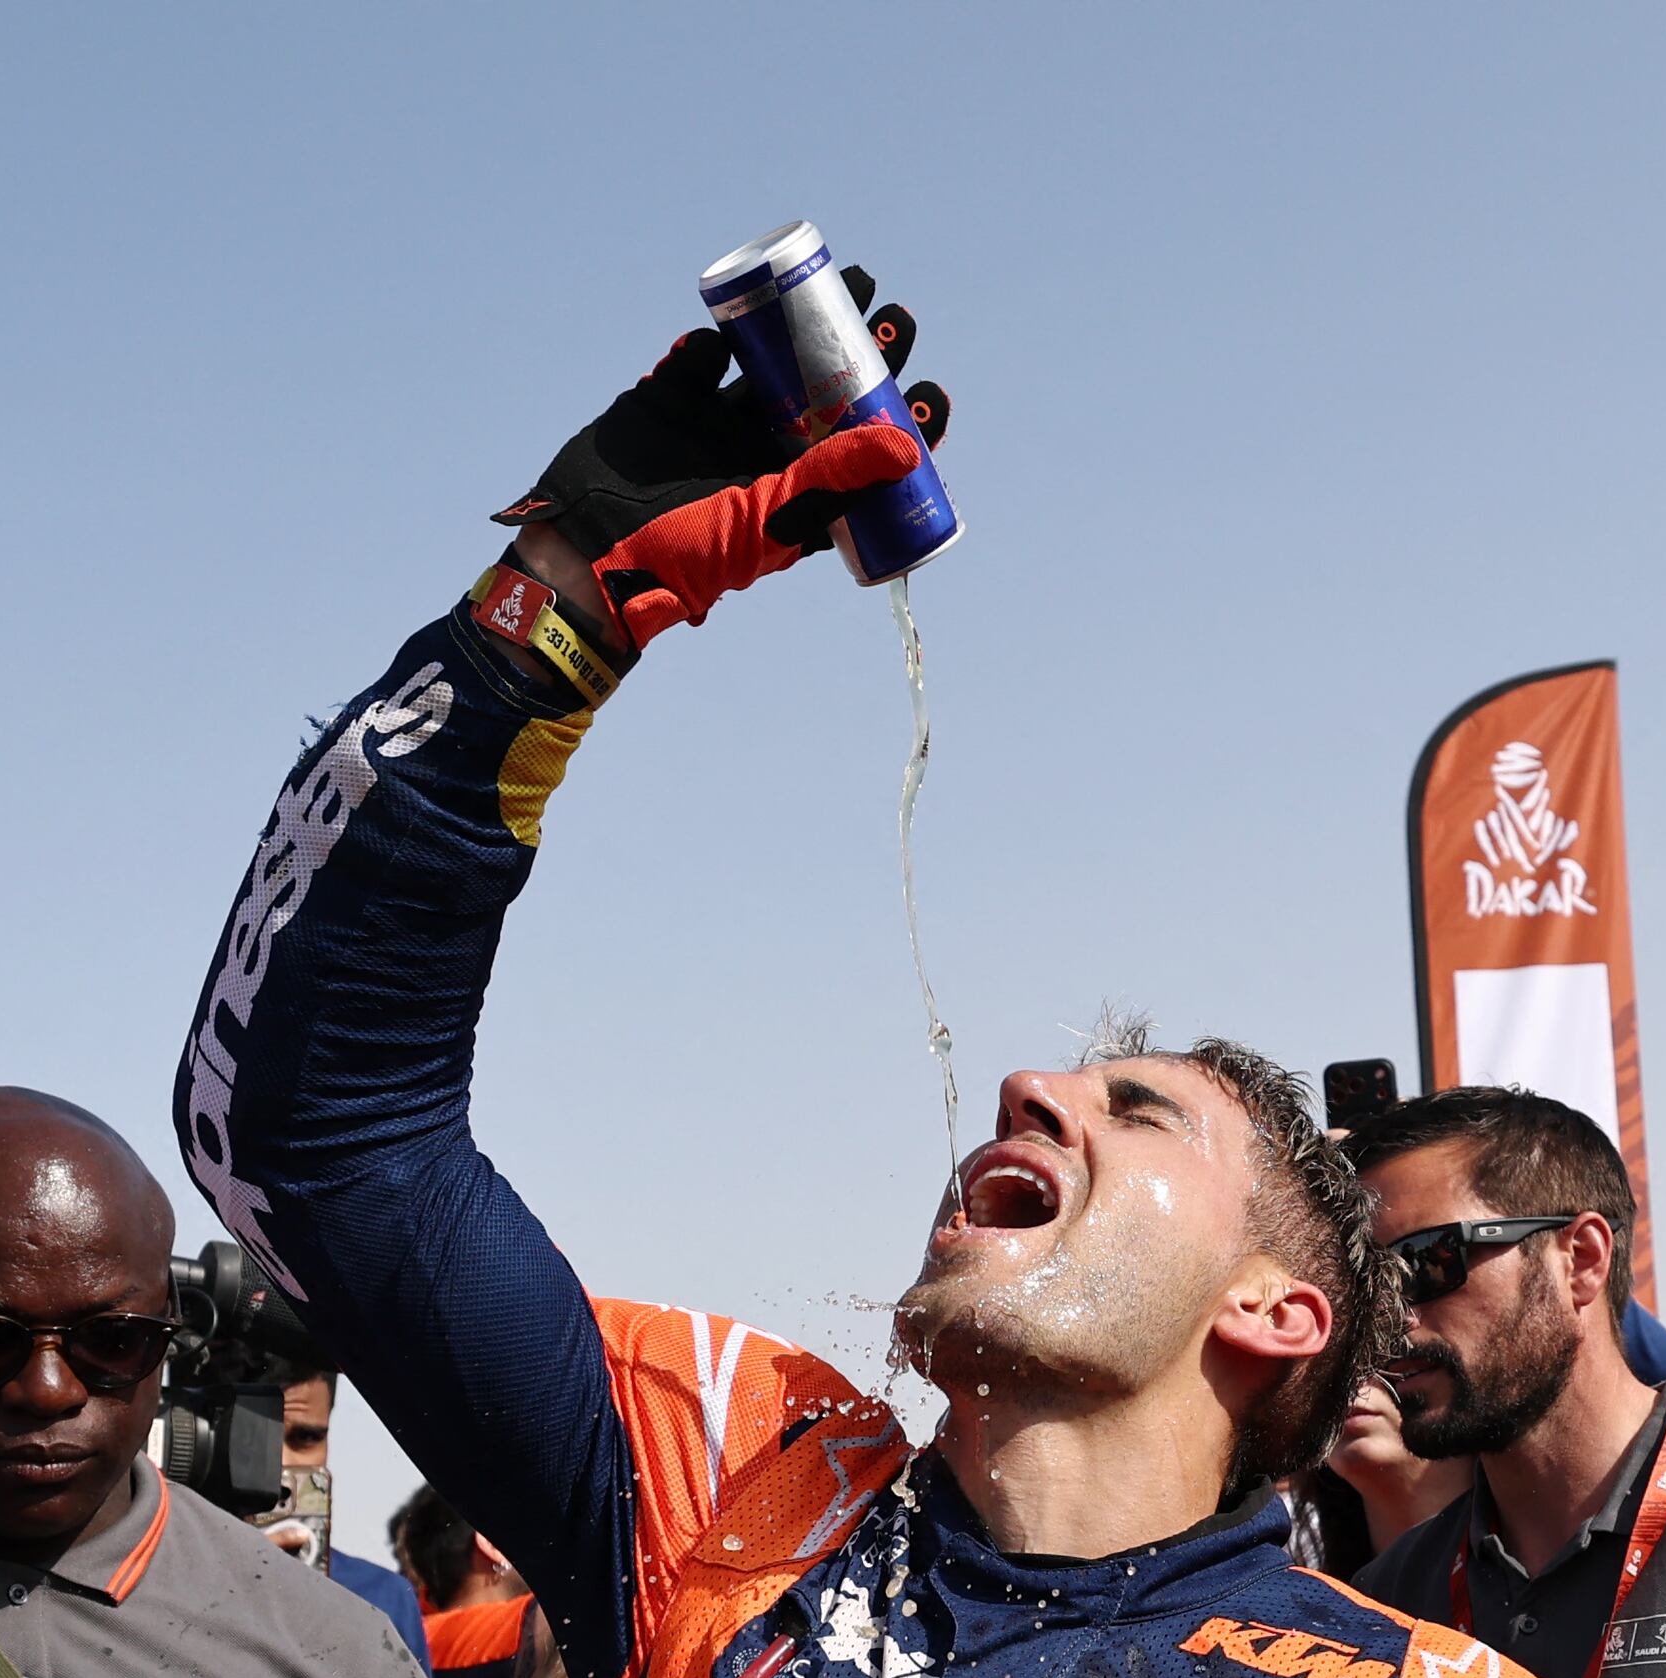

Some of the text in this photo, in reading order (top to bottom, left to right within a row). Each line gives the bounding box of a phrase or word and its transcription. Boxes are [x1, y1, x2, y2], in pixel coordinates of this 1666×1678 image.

[491, 608, 519, 635] DAKAR
[1463, 857, 1597, 918] DAKAR
[1634, 1647, 1660, 1657] SAUDI
